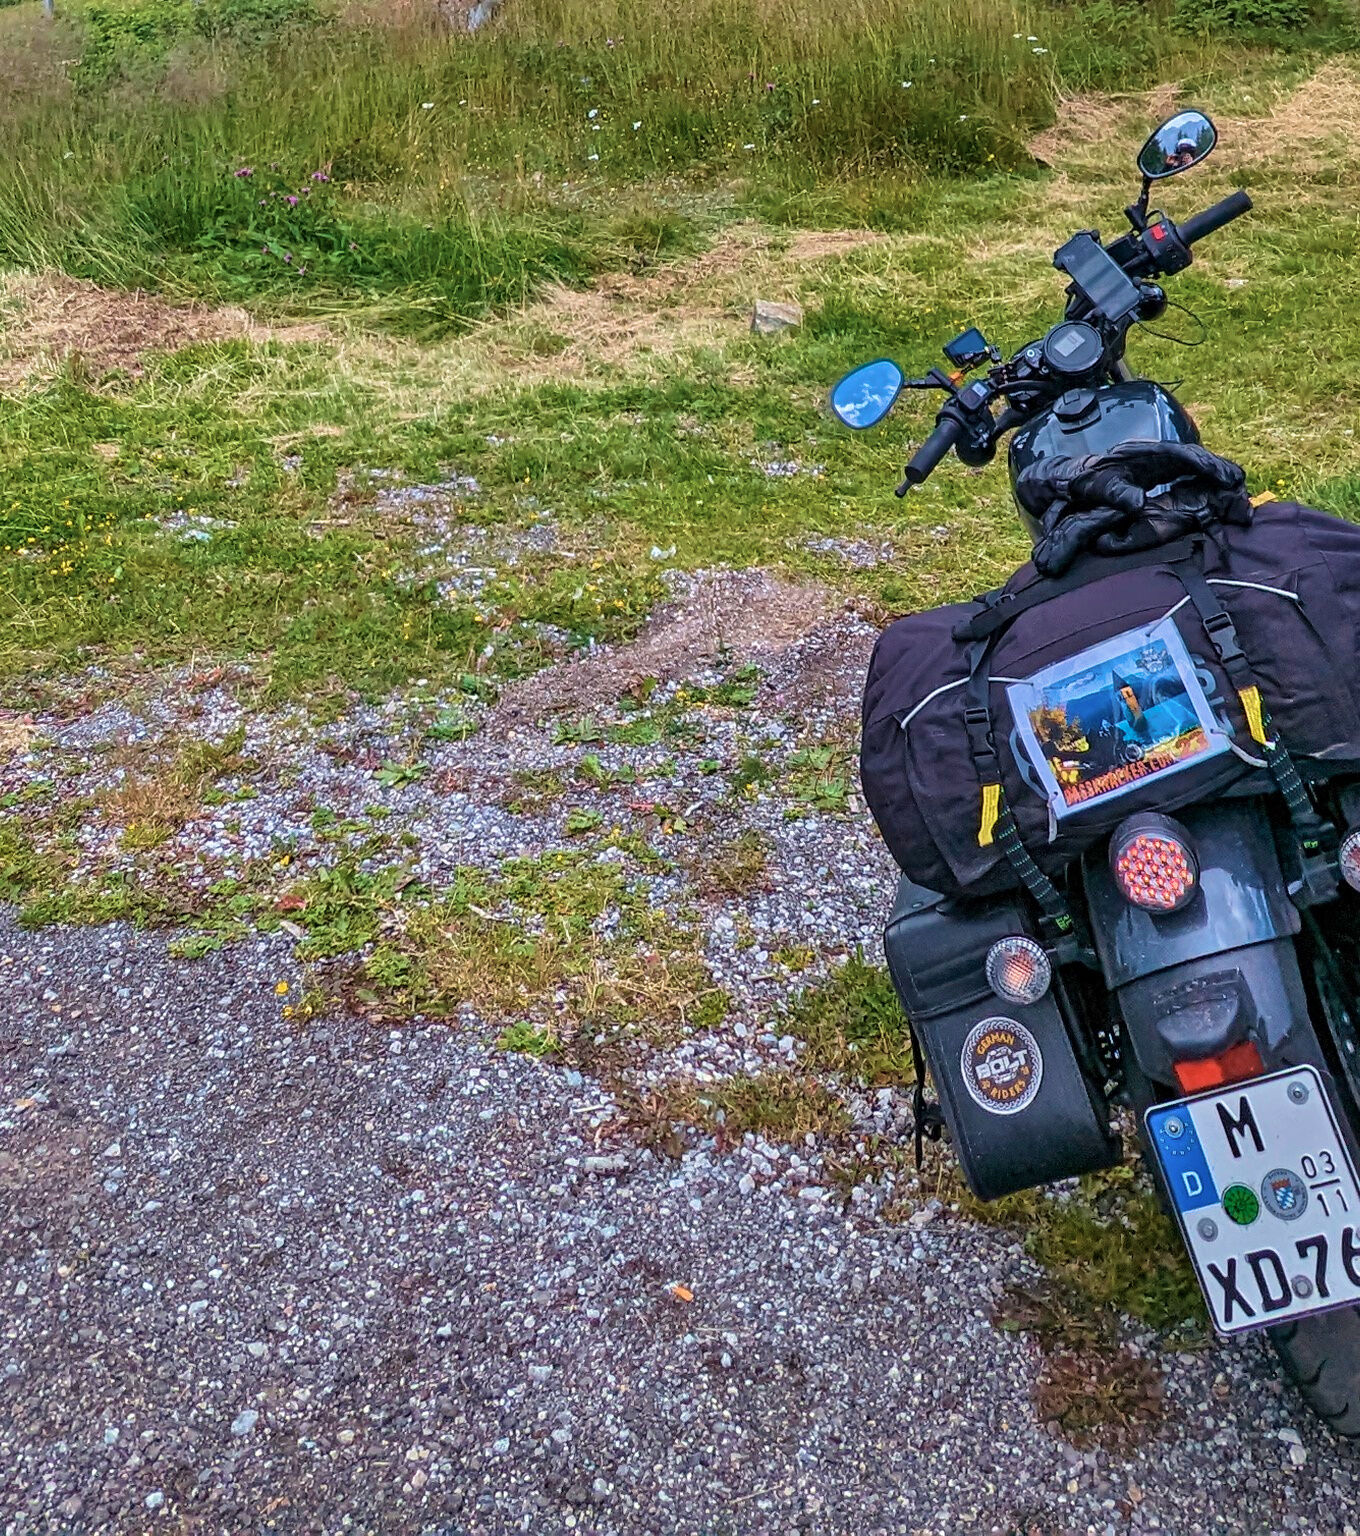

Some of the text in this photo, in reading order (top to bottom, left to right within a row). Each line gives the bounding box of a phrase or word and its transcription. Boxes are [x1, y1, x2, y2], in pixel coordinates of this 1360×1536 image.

[976, 1033, 1014, 1055] GERMAN
[975, 1049, 1028, 1080] BOLT
[990, 1079, 1026, 1100] RIDERS
[1216, 1095, 1265, 1158] M
[1301, 1151, 1336, 1179] 03
[1181, 1171, 1203, 1197] D
[1316, 1189, 1349, 1217] 11
